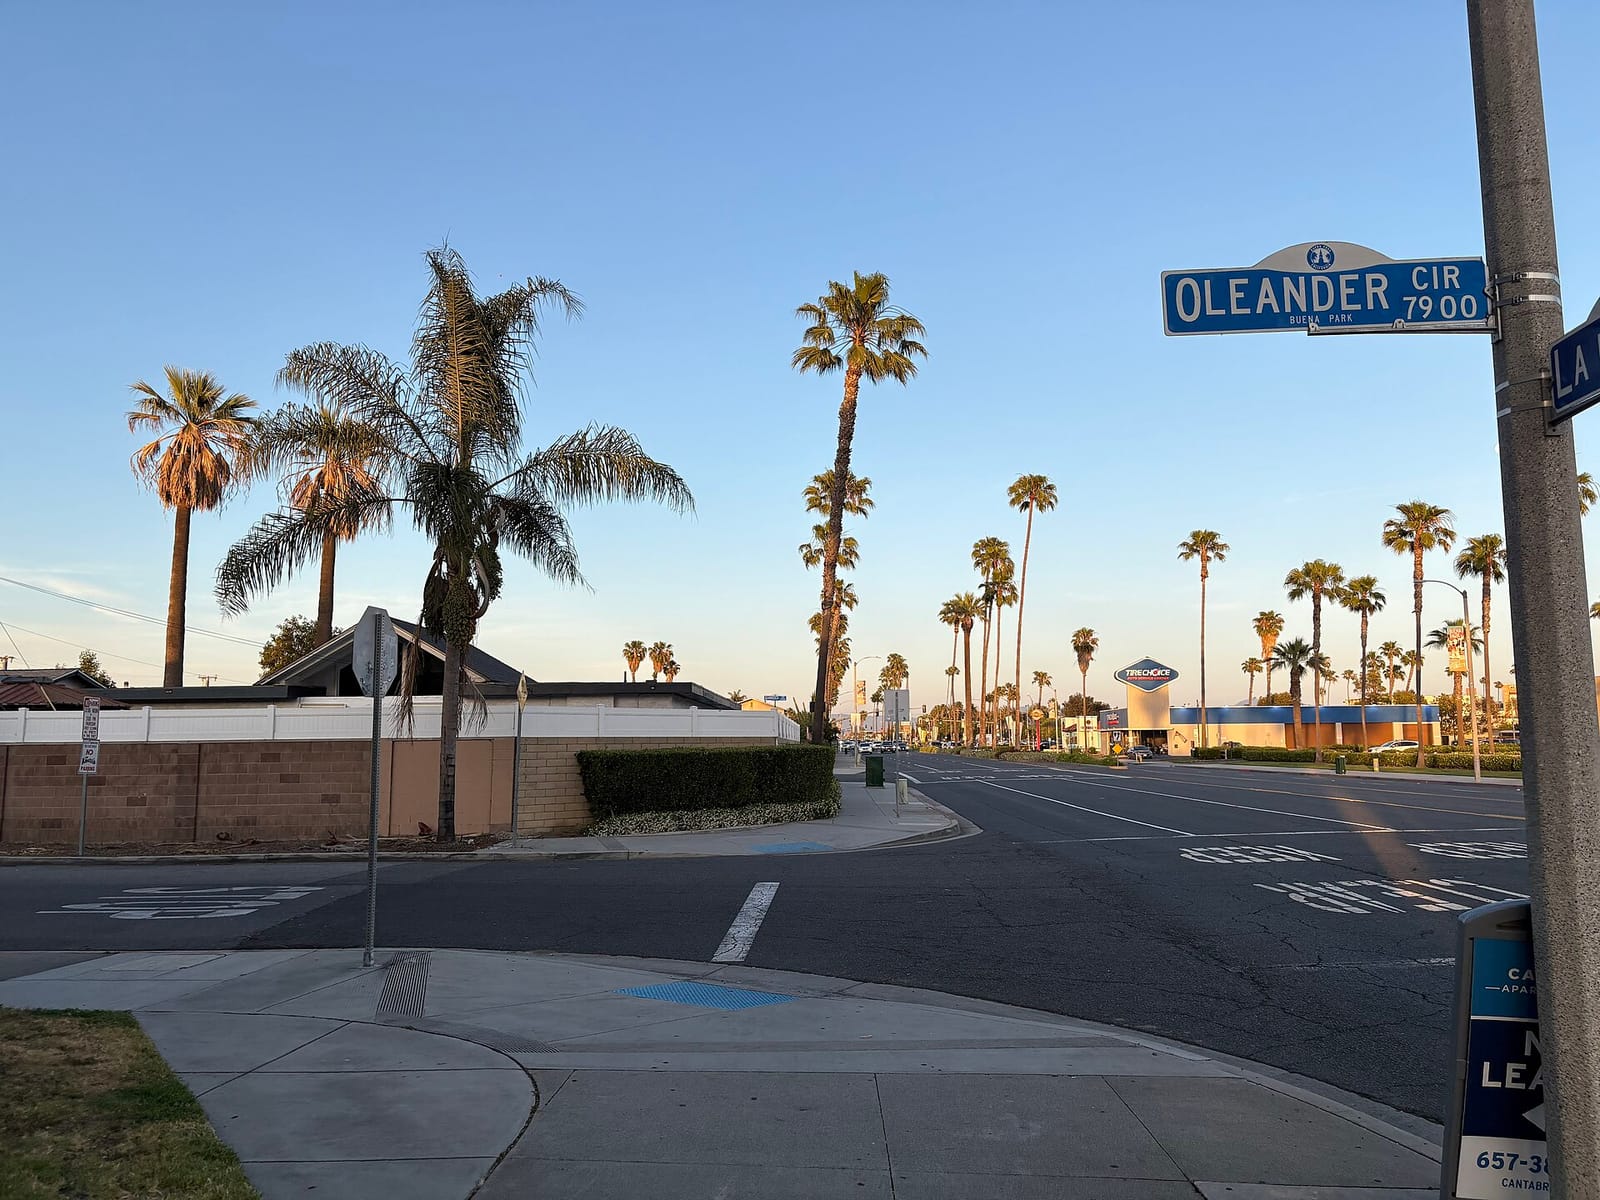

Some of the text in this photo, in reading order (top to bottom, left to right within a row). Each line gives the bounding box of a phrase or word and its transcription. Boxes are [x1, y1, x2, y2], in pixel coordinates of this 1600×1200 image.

[1175, 266, 1461, 323] OLEANDER CIR
[1402, 294, 1478, 320] 7900
[1289, 313, 1353, 324] BUENA PARK
[1553, 344, 1590, 400] LA
[36, 886, 325, 919] STOP
